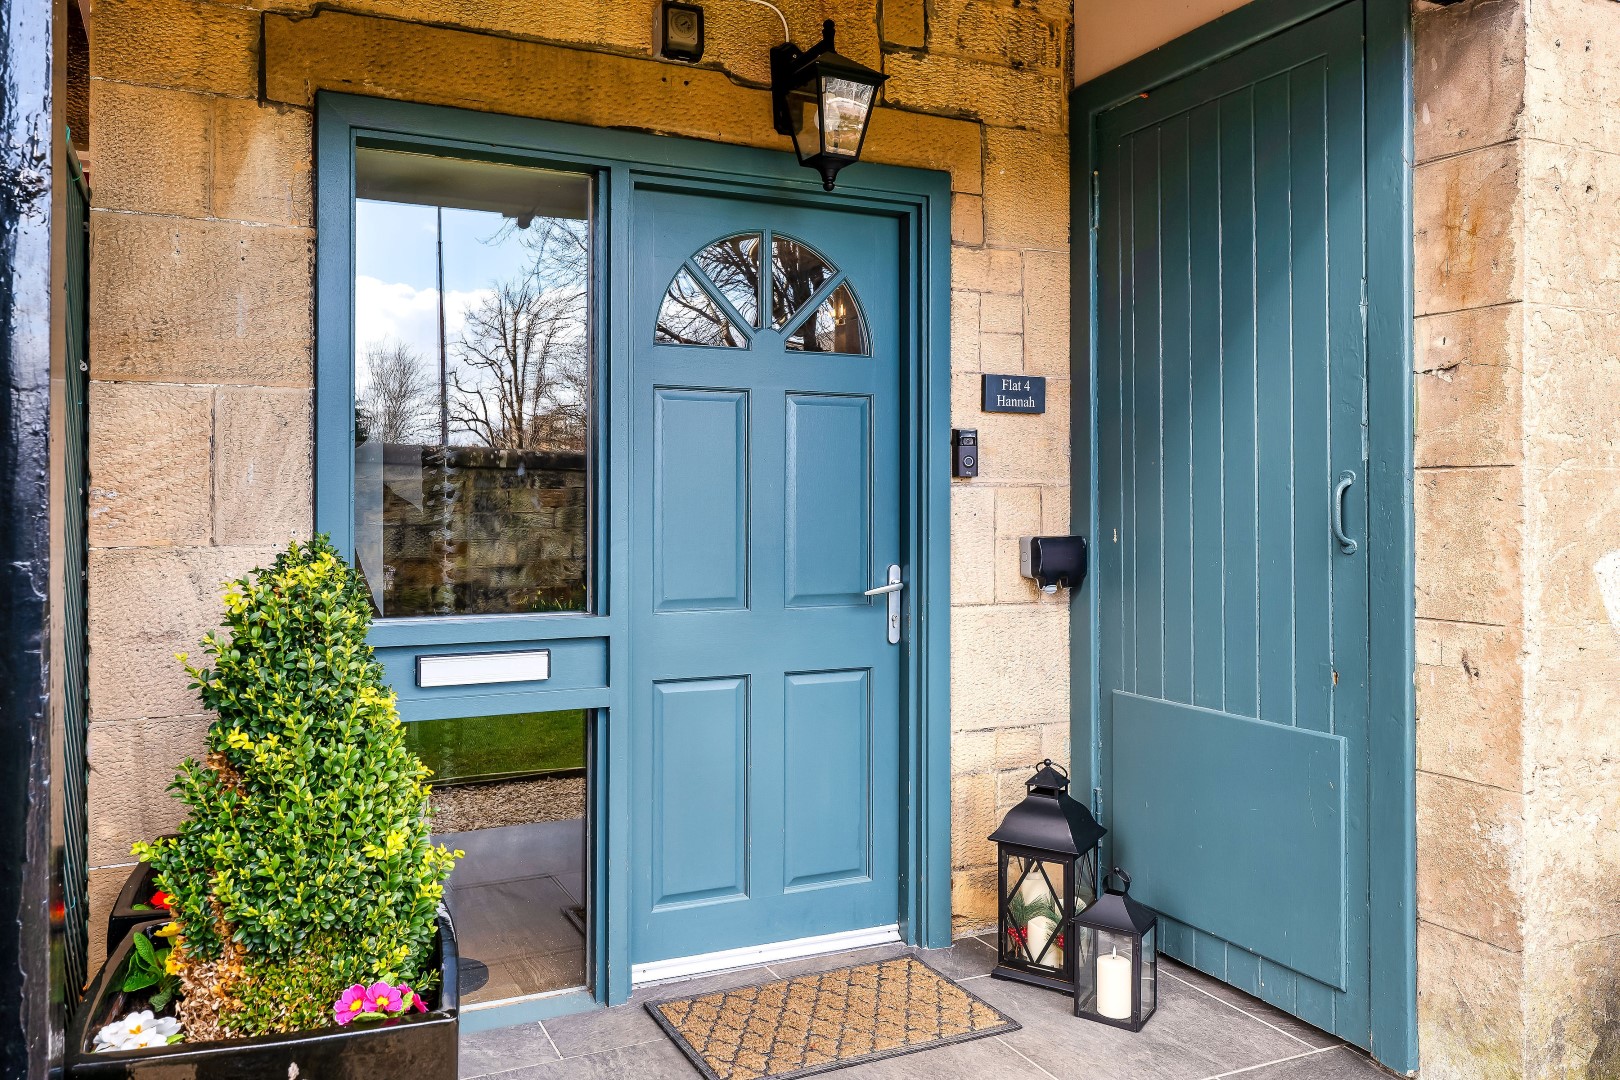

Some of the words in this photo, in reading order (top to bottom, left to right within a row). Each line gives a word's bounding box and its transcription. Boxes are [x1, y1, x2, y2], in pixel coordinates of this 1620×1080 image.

[1002, 379, 1021, 391] Flat
[1024, 380, 1030, 391] 4
[997, 395, 1035, 407] Hannah
